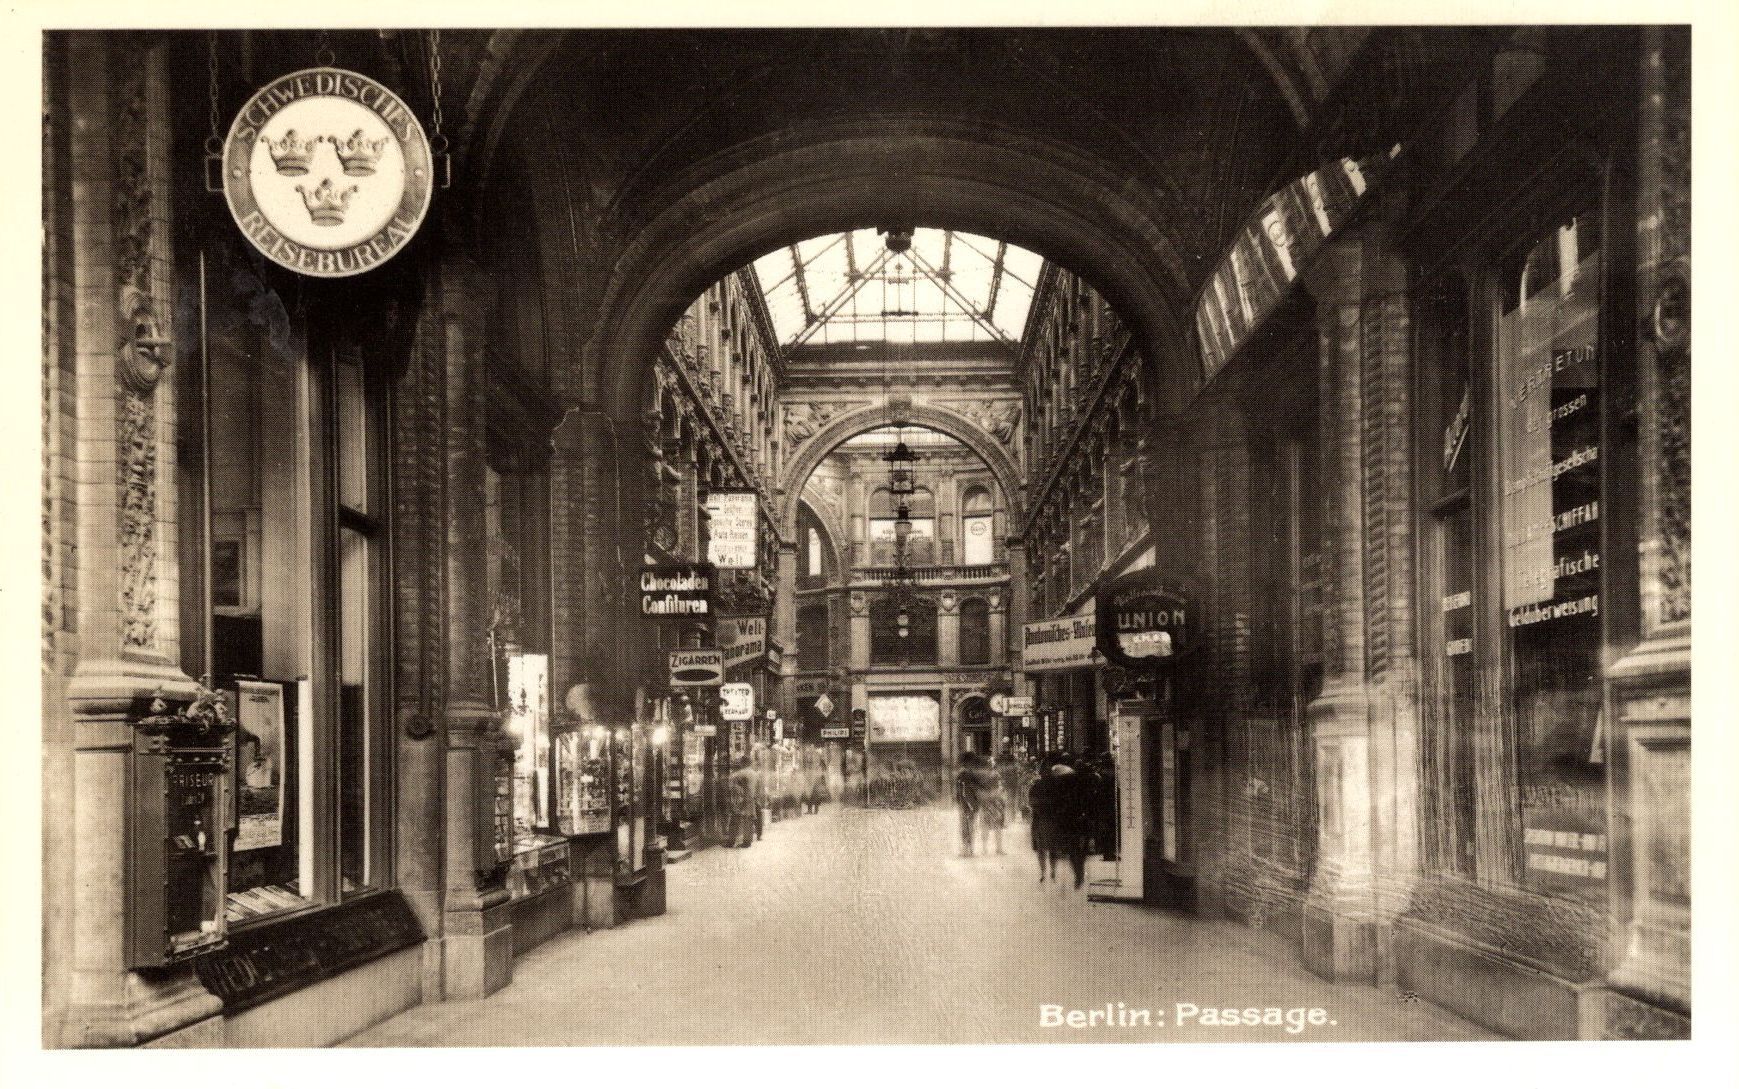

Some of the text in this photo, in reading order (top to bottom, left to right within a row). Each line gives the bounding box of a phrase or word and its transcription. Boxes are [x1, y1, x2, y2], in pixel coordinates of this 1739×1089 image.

[236, 74, 416, 142] SCHWEDISCHES
[242, 210, 418, 273] REISEBUREAU
[640, 571, 709, 592] Chocoladen
[1117, 610, 1186, 629] UNION
[671, 653, 721, 669] ZIGARREN
